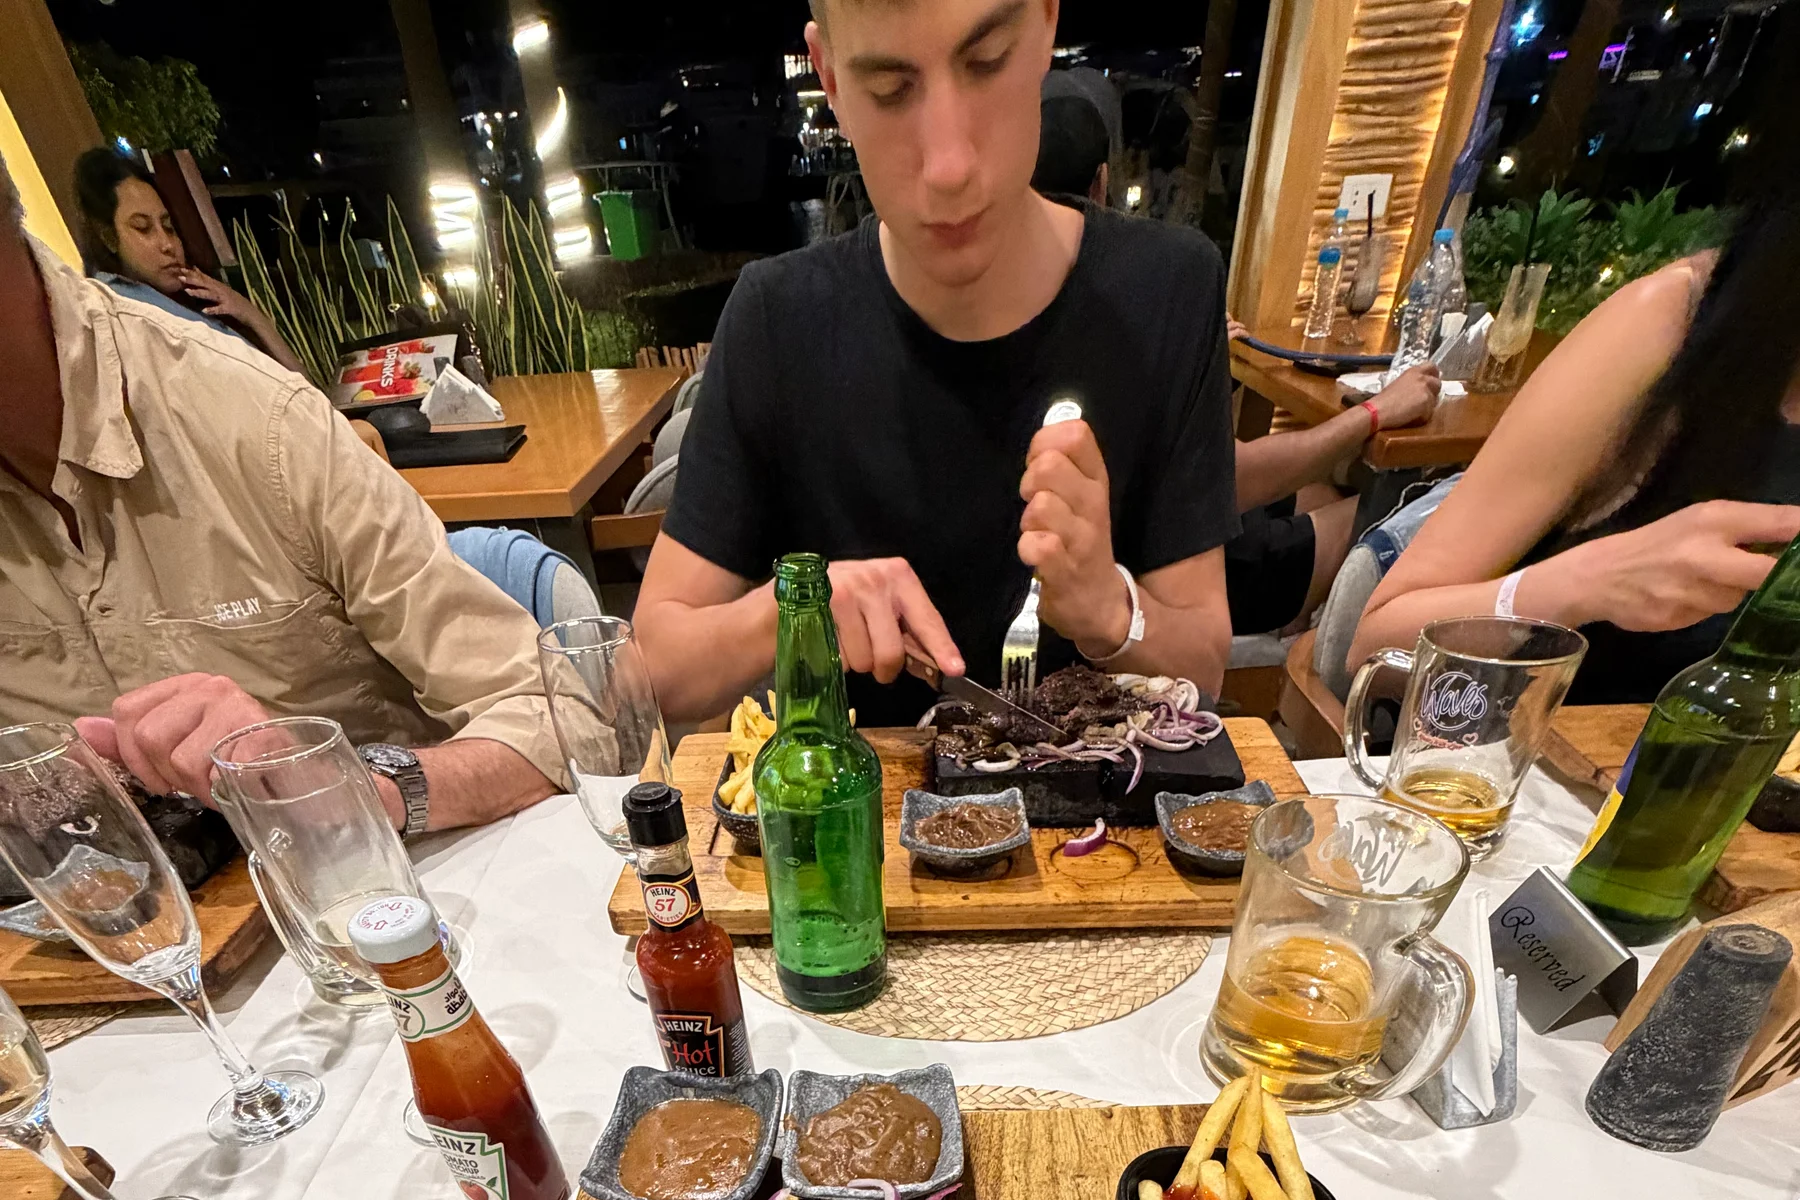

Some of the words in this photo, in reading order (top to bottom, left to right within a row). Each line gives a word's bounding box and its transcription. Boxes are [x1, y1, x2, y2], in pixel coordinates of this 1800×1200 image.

[380, 346, 399, 388] DRINKS
[650, 887, 676, 897] HEINZ
[654, 898, 676, 912] 57
[653, 911, 683, 922] VARIETIES
[1501, 906, 1587, 992] Reserved
[664, 1021, 703, 1033] HEINZ
[672, 1040, 715, 1066] Hot
[433, 1133, 476, 1155] EINZ
[442, 1152, 478, 1168] OMATO
